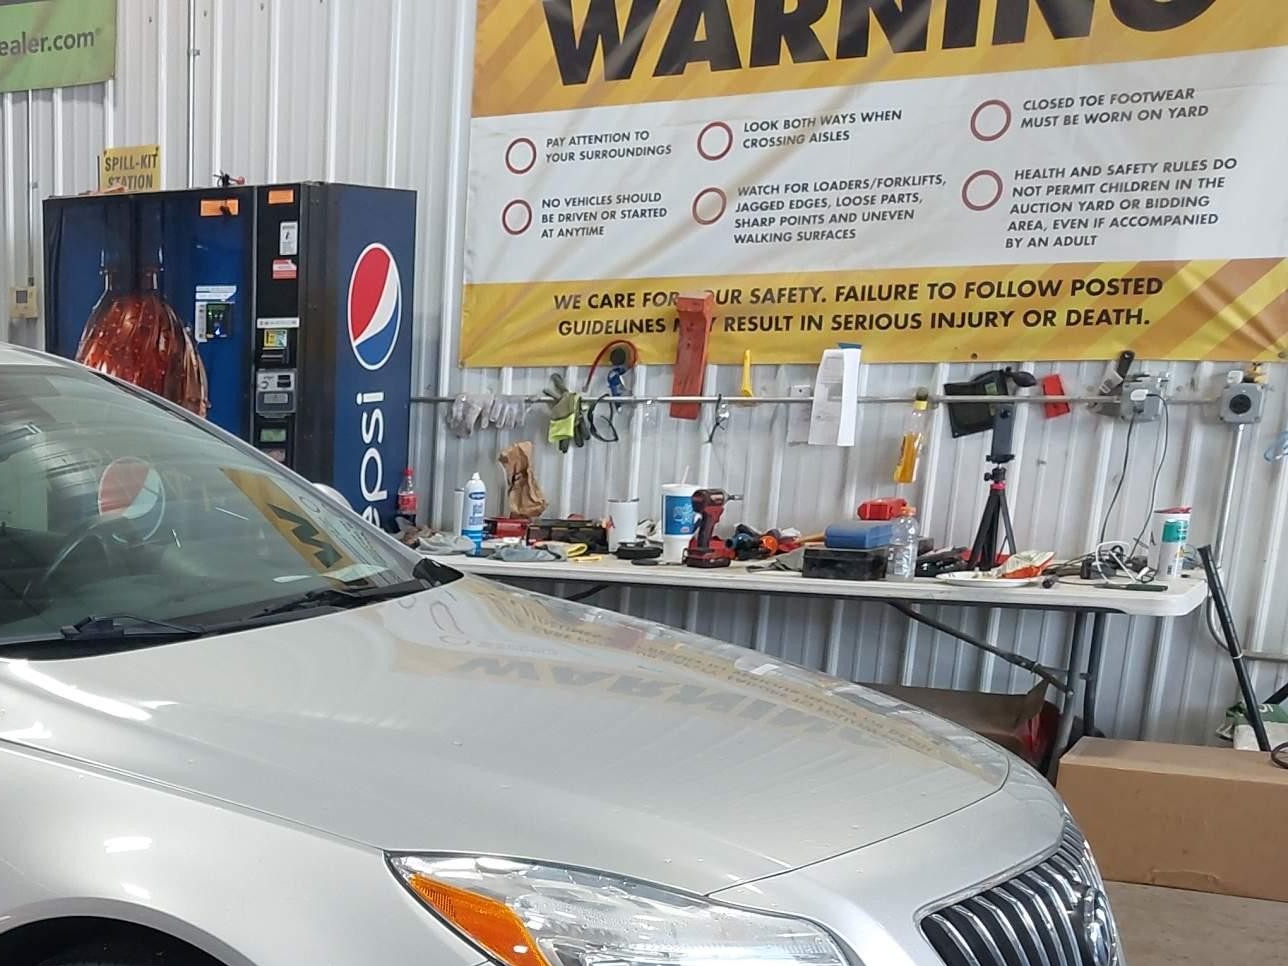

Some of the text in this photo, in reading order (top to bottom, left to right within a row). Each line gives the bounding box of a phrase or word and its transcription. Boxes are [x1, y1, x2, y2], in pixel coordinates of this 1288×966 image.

[1023, 88, 1195, 111] CLOSED TOE FOOTWEAR
[744, 109, 902, 133] LOOK BOTH WAYS WHEN
[1021, 105, 1209, 128] MUST BE WORN ON YARD
[546, 130, 650, 148] PAY ATTENTION TO
[743, 130, 850, 149] CROSSING AISLES
[105, 154, 158, 171] SPILL-KIT
[546, 144, 672, 163] YOUR SURROUNDINGS
[1014, 158, 1237, 181] HEALTH AND SAFETY RULES DO
[738, 174, 947, 196] WATCH FOR LOADERS/FORKLIFTS,
[1012, 177, 1225, 198] NOT PERMIT CHILDREN IN THE
[542, 192, 662, 209] NO VEHICLES SHOULD
[735, 192, 923, 213] JAGGED EDGES, LOOSE PARTS,
[1009, 196, 1210, 214] AUCTION YARD OR BIDDING
[542, 208, 668, 223] BE DRIVEN OR STARTED
[734, 209, 914, 228] SHARP POINTS AND UNEVEN
[1007, 213, 1219, 232] AREA, EVEN IF ACCOMPANIED
[541, 226, 605, 238] AT ANYTIME
[734, 229, 856, 244] WALKING SURFACES
[1005, 235, 1098, 249] BY AN ADULT
[554, 294, 582, 310] WE
[588, 292, 638, 309] CARE
[642, 292, 680, 307] FOR
[750, 287, 827, 304] SAFETY.
[835, 283, 918, 303] FAILURE
[927, 282, 956, 299] TO
[964, 279, 1063, 299] FOLLOW
[1071, 278, 1163, 297] POSTED
[558, 318, 666, 335] GUIDELINES
[724, 315, 794, 332] RESULT
[800, 315, 823, 331] IN
[831, 312, 922, 330] SERIOUS
[930, 310, 1015, 329] INJURY
[1022, 309, 1056, 327] OR
[1065, 308, 1150, 326] DEATH.
